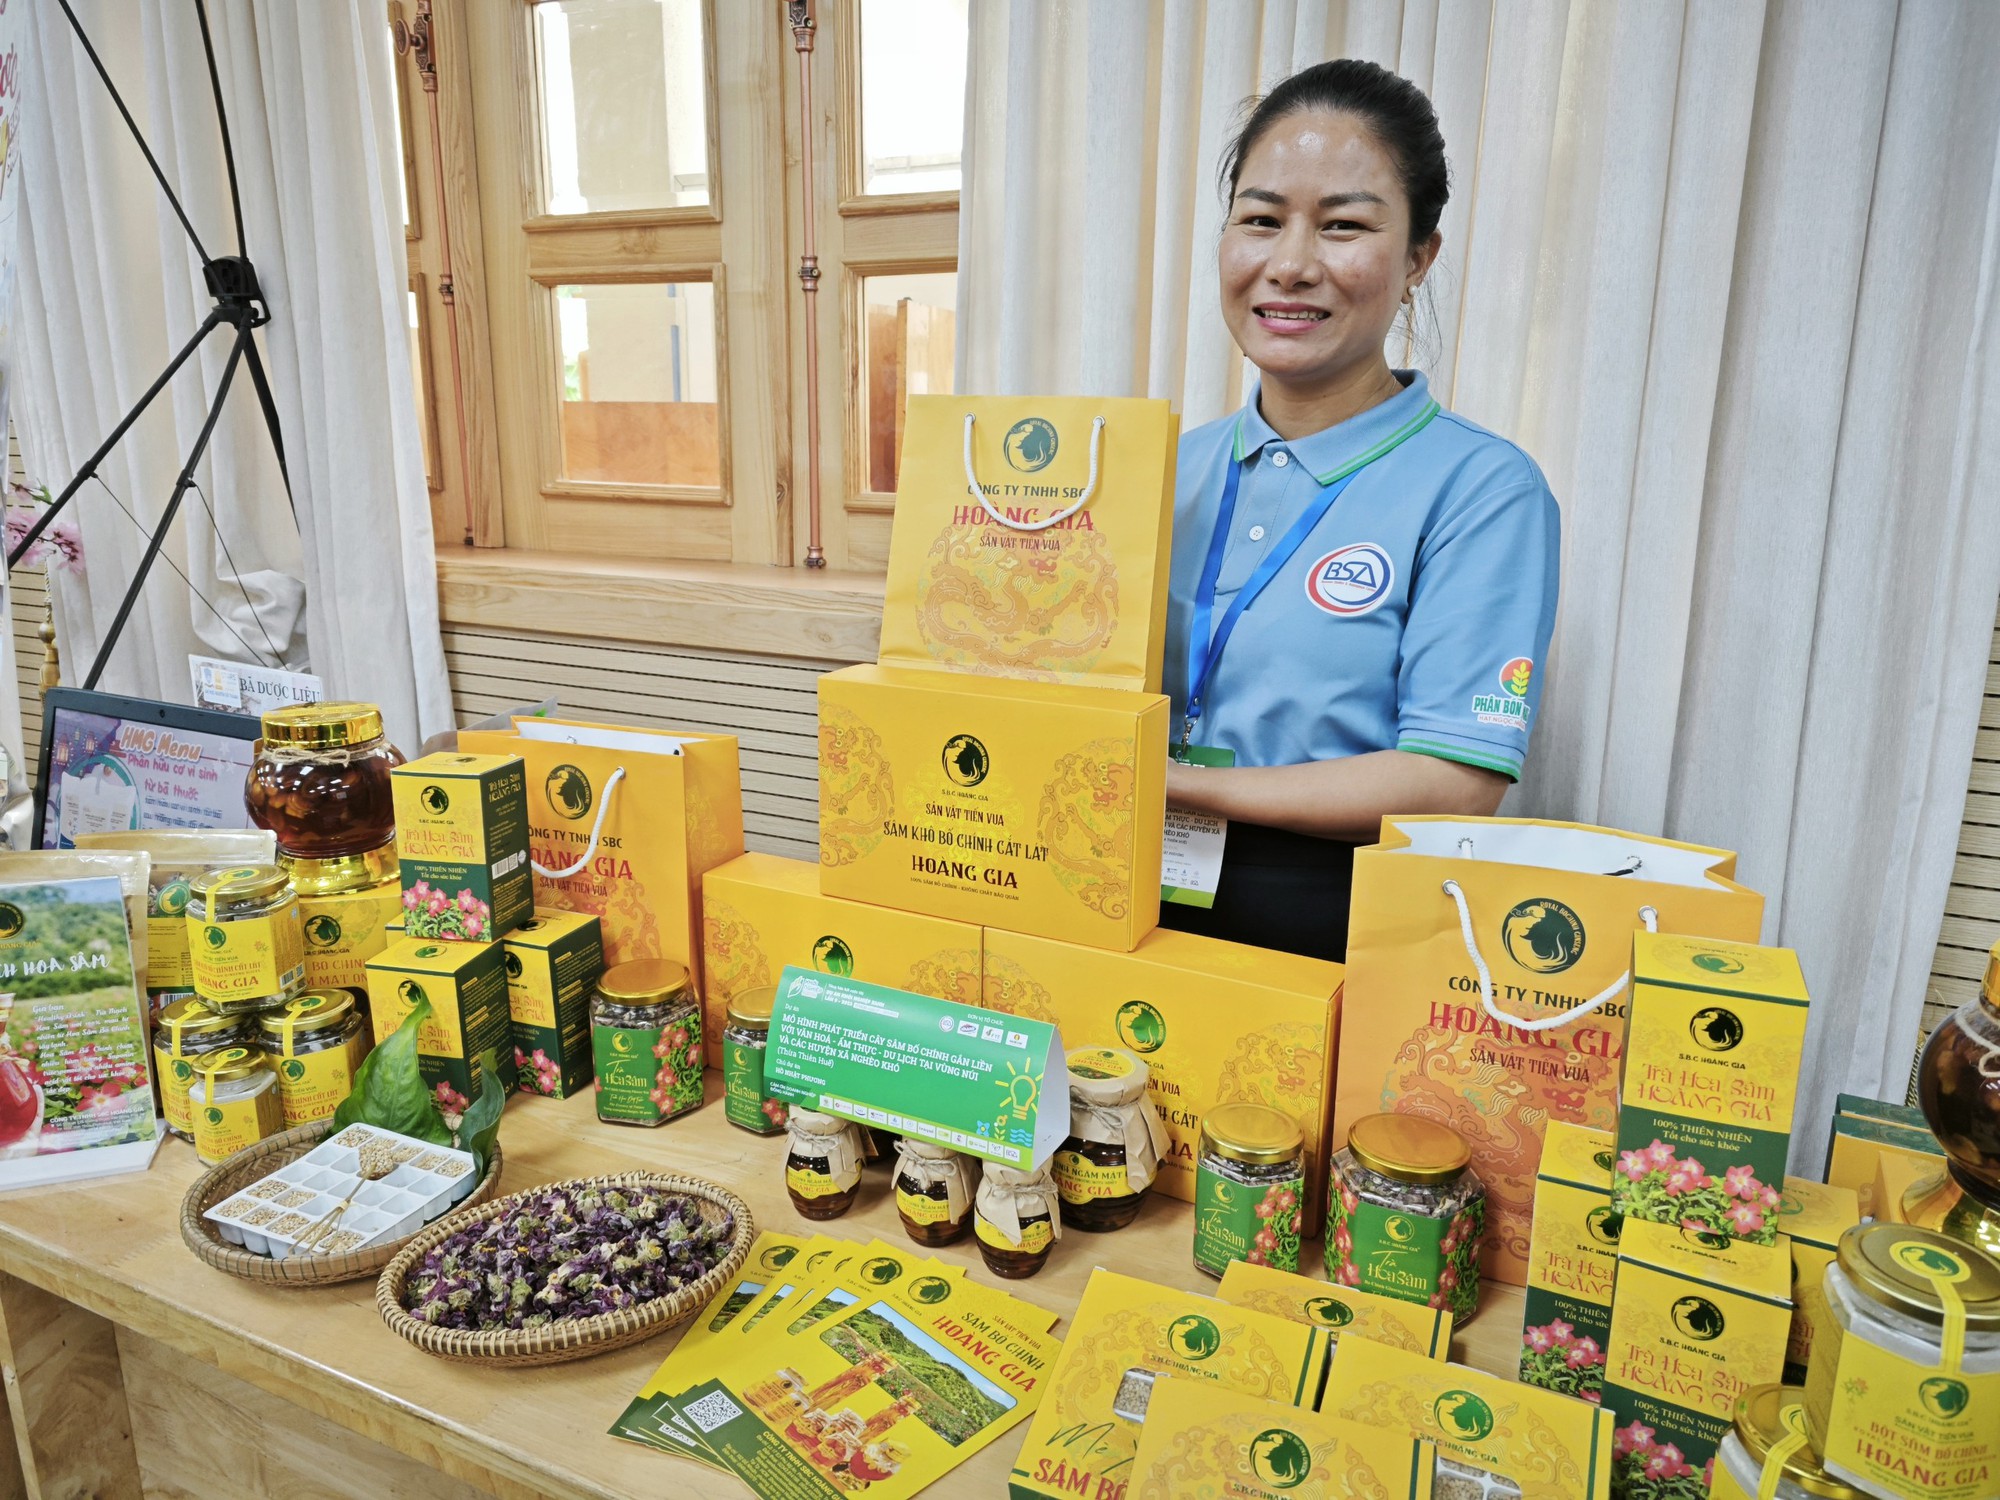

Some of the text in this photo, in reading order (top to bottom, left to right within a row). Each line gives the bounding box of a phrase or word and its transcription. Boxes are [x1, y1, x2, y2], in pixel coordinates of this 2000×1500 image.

[1004, 485, 1058, 498] TY TNHH
[1042, 538, 1060, 551] VUA
[1323, 561, 1377, 589] BSA
[240, 676, 255, 694] BÃ
[257, 680, 290, 702] DƯỢC
[1474, 696, 1522, 716] PHÂN BÓN
[121, 725, 202, 762] HMG Menu
[127, 754, 218, 782] Phân hữu cơ vi sinh
[144, 778, 199, 801] từ bã thuốc
[925, 801, 1004, 827] SẢN VẬT TIẾN VUA
[553, 829, 623, 849] TY SBC
[883, 818, 1049, 862] SÂM KHÔ BỐ CHÍNH CẮT LÁT
[595, 856, 633, 881] GIA
[912, 853, 1018, 889] HOÀNG GIA
[593, 883, 607, 897] VUA
[23, 952, 111, 976] HOA SÂM
[233, 976, 259, 988] GIA
[1505, 985, 1528, 1002] TY
[1428, 1001, 1556, 1049] HOÀNG
[779, 1034, 900, 1074] VÀ CÁC HUYỆN XÃ NGHÈO KHÓ
[781, 1024, 979, 1082] VỚI VĂN HOÁ ẨM THỰC DU LỊCH TẠI VÙNG NÚI
[783, 1013, 993, 1074] MÔ HÌNH PHÁT TRIỂN CÂY SÂM BỐ CHÍNH GẮN LIỀN
[777, 1046, 834, 1069] (Thừa Thiên Huế)
[1470, 1045, 1590, 1083] SẢN VẬT TIẾN VUA
[1731, 1061, 1746, 1070] GIA
[1161, 1080, 1181, 1097] VUA
[1642, 1063, 1775, 1101] Trà Hoa Sâm
[1638, 1083, 1771, 1122] HOÀNG GIA
[1171, 1105, 1199, 1130] CẮT
[1653, 1118, 1753, 1144] 100% THIÊN NHIÊN
[1663, 1130, 1715, 1148] Tốt cho sức
[1087, 1184, 1113, 1197] GIA
[1372, 1250, 1408, 1269] Trà
[1397, 1270, 1427, 1291] Sâm
[1554, 1300, 1608, 1319] 100% THIÊN
[1578, 1315, 1593, 1325] cho
[932, 1315, 1037, 1393] HOÀNG GIA
[961, 1312, 991, 1333] SÂM
[1005, 1342, 1045, 1371] CHÍNH
[1625, 1342, 1703, 1382] Trà Hoa
[1711, 1352, 1726, 1362] GIA
[1204, 1370, 1219, 1381] GIA
[1620, 1362, 1703, 1404] HOÀNG
[1634, 1399, 1695, 1424] 100% THIÊN
[1643, 1411, 1696, 1437] Tốt cho sức
[762, 1430, 835, 1496] CÔNG TY TNHH SBC HOÀNG
[1480, 1451, 1499, 1465] GIA
[1856, 1438, 1989, 1488] HOÀNG GIA
[1034, 1457, 1090, 1497] SÂM
